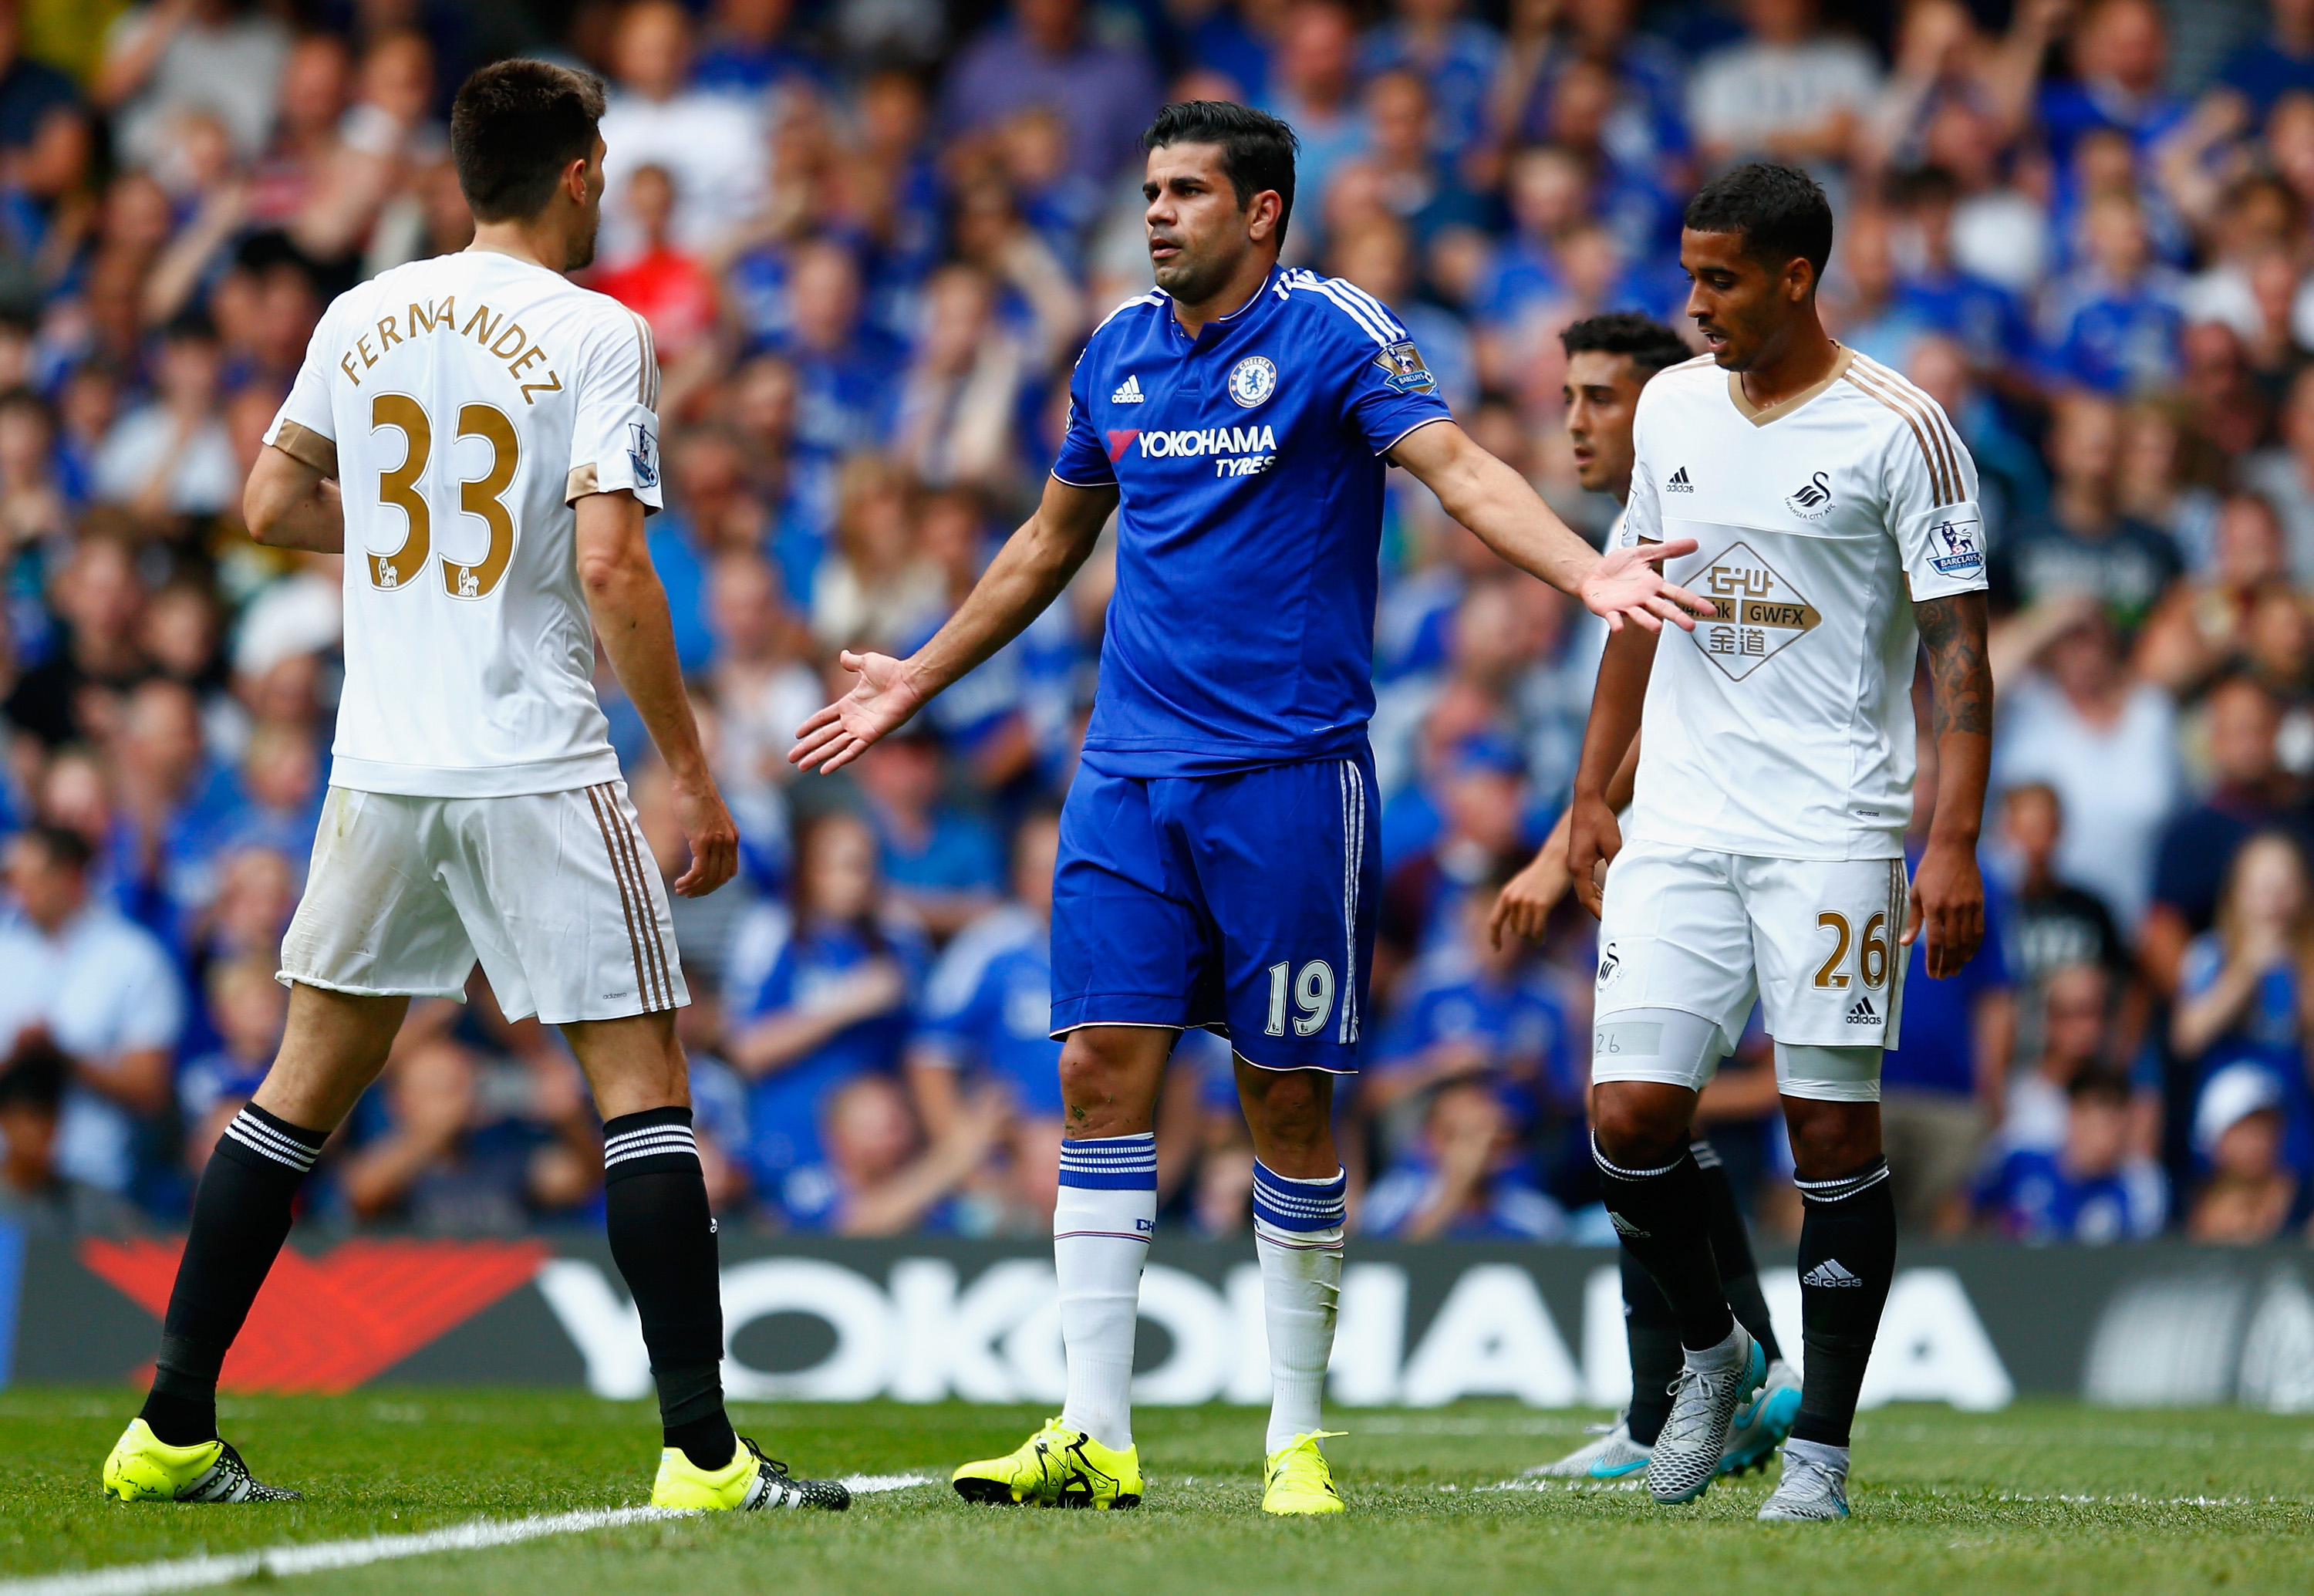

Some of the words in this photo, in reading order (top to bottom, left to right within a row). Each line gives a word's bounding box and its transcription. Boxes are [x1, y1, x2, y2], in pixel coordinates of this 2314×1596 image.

[340, 295, 565, 406] FERNANDEZ
[1239, 358, 1270, 370] CHELSEA
[1398, 373, 1425, 384] BARCLAYS
[1111, 393, 1145, 404] adidas
[1138, 425, 1277, 458] YOKOHAMA
[1216, 455, 1277, 477] TYRES
[364, 391, 522, 601] 33
[1666, 483, 1694, 494] adidas
[1784, 497, 1807, 519] SWANSEA
[1824, 503, 1836, 515] AFC
[1940, 555, 1978, 567] BARCLAYS
[1749, 606, 1805, 626] GWFX
[1709, 626, 1766, 657] 金道
[1813, 909, 1889, 990] 26
[1264, 960, 1334, 1037] 19
[1846, 1014, 1882, 1025] adidas
[1596, 1034, 1621, 1054] 26
[1803, 1275, 1862, 1287] adidas
